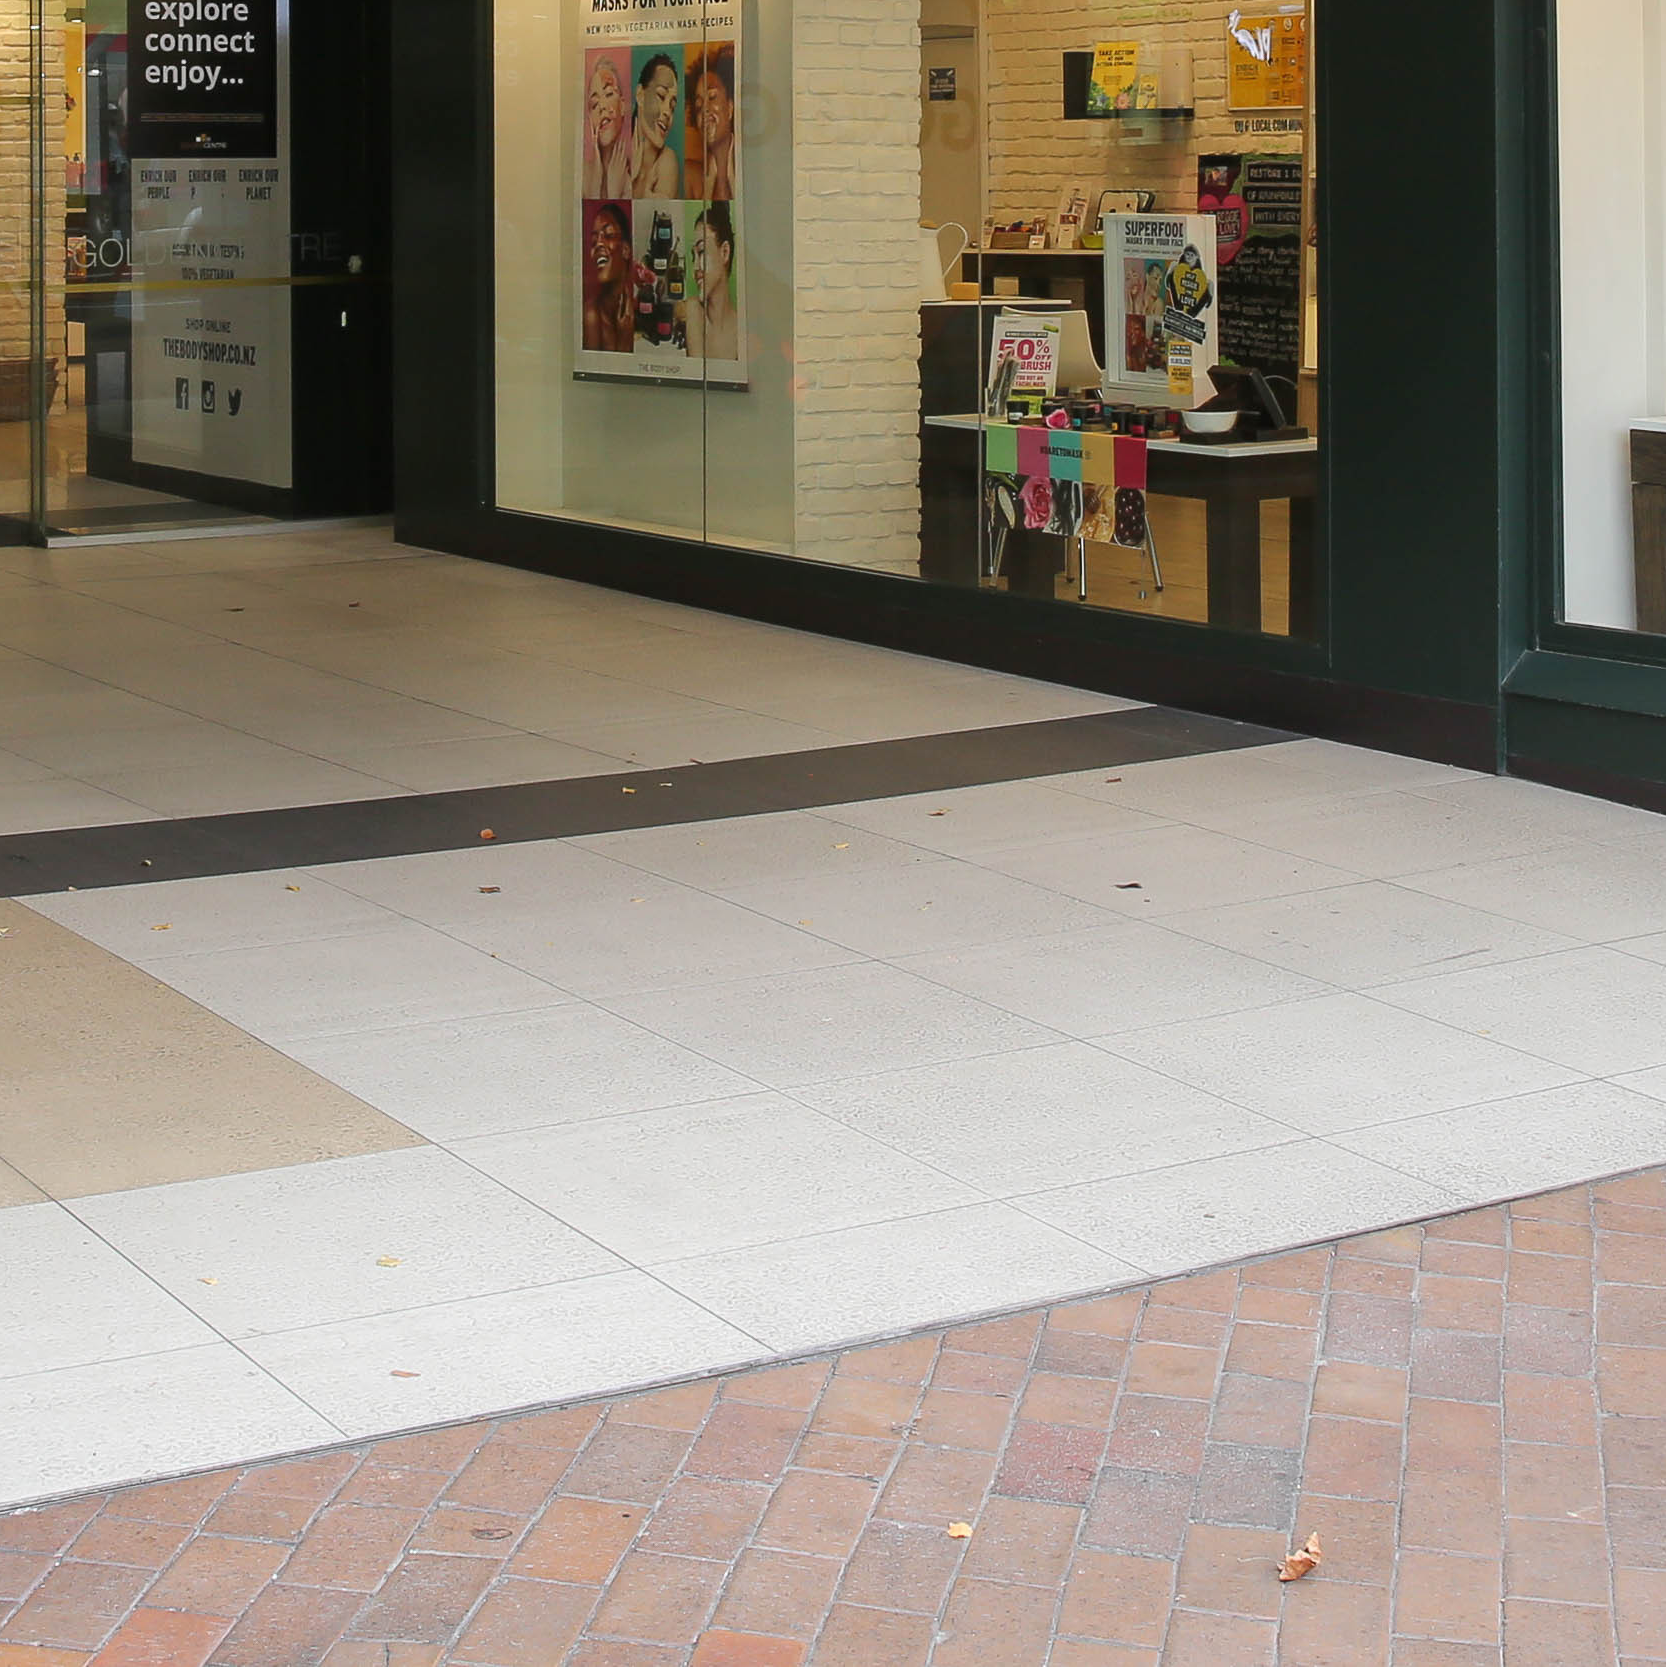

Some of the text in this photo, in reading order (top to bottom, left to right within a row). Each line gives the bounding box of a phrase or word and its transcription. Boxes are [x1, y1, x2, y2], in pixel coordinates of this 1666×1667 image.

[586, 24, 601, 35] NEW
[624, 21, 675, 33] VEGETARIAN
[677, 18, 698, 30] MASK
[700, 16, 734, 28] RECIPES
[144, 30, 255, 54] connect
[144, 58, 244, 91] enjoy...
[1251, 118, 1272, 132] LOCAL
[245, 186, 271, 201] PLANET
[1020, 361, 1052, 371] BRUSH
